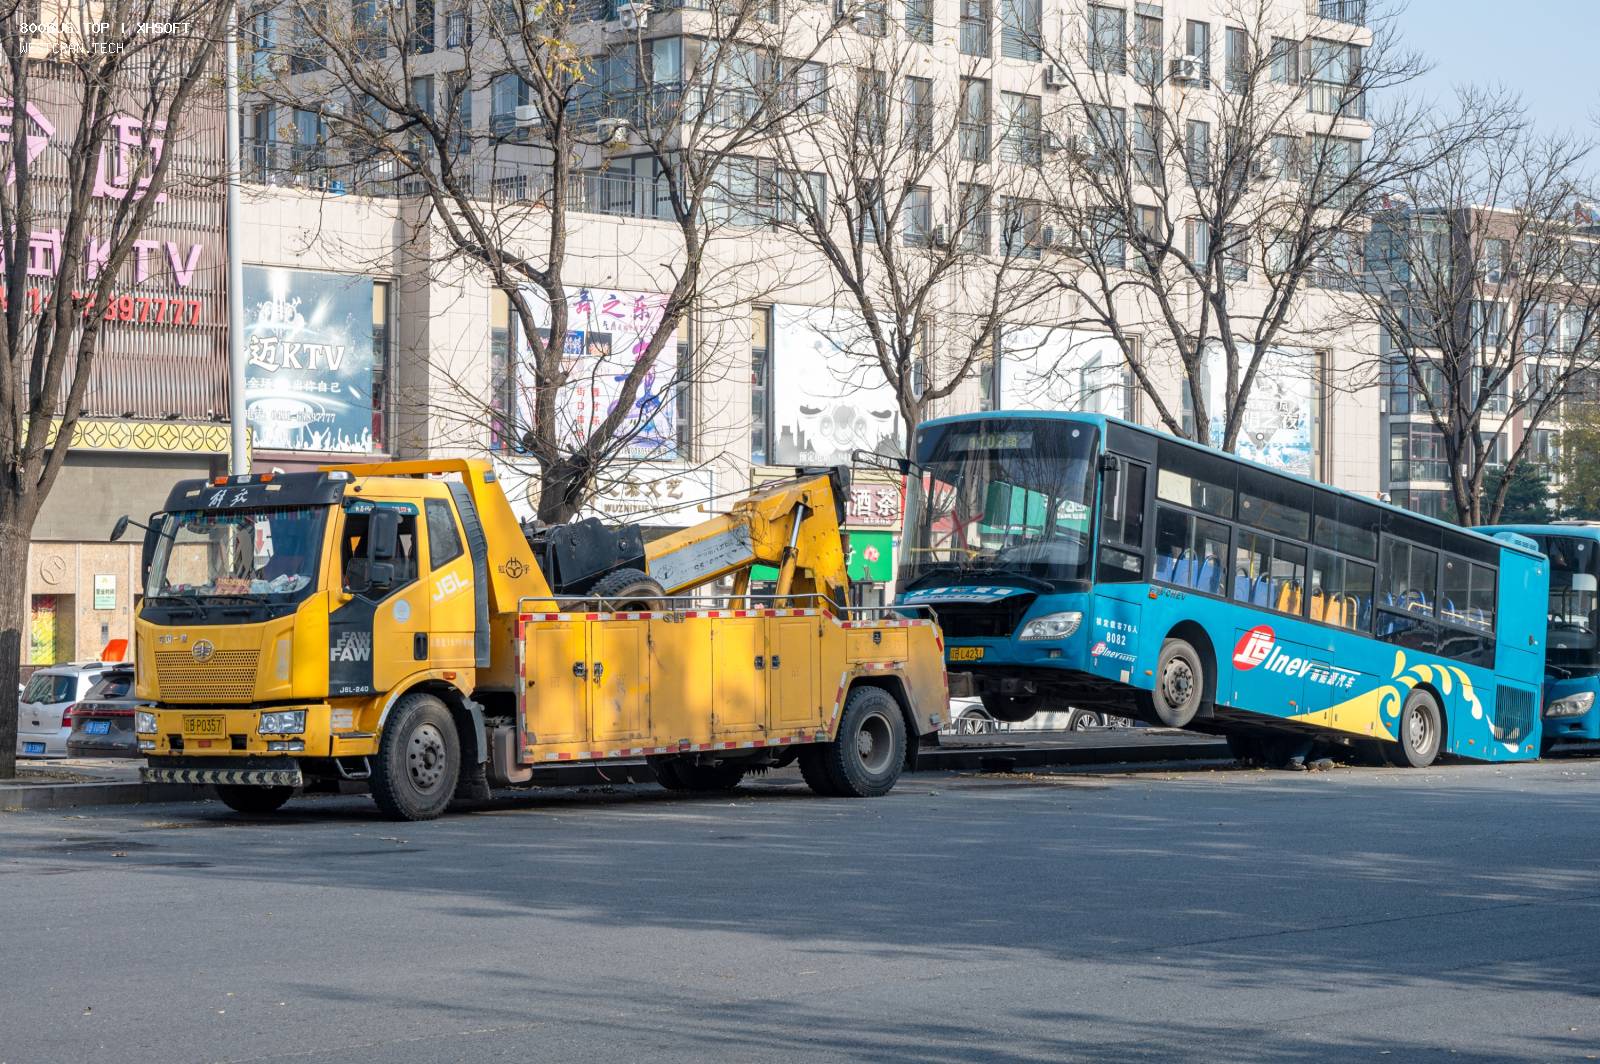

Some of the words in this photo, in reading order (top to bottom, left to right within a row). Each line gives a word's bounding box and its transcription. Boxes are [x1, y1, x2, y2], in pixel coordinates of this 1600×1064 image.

[244, 335, 345, 373] 迈KTV
[432, 571, 469, 601] JBL
[336, 640, 370, 648] FAW
[1106, 631, 1126, 646] 8082
[330, 648, 371, 661] FAW
